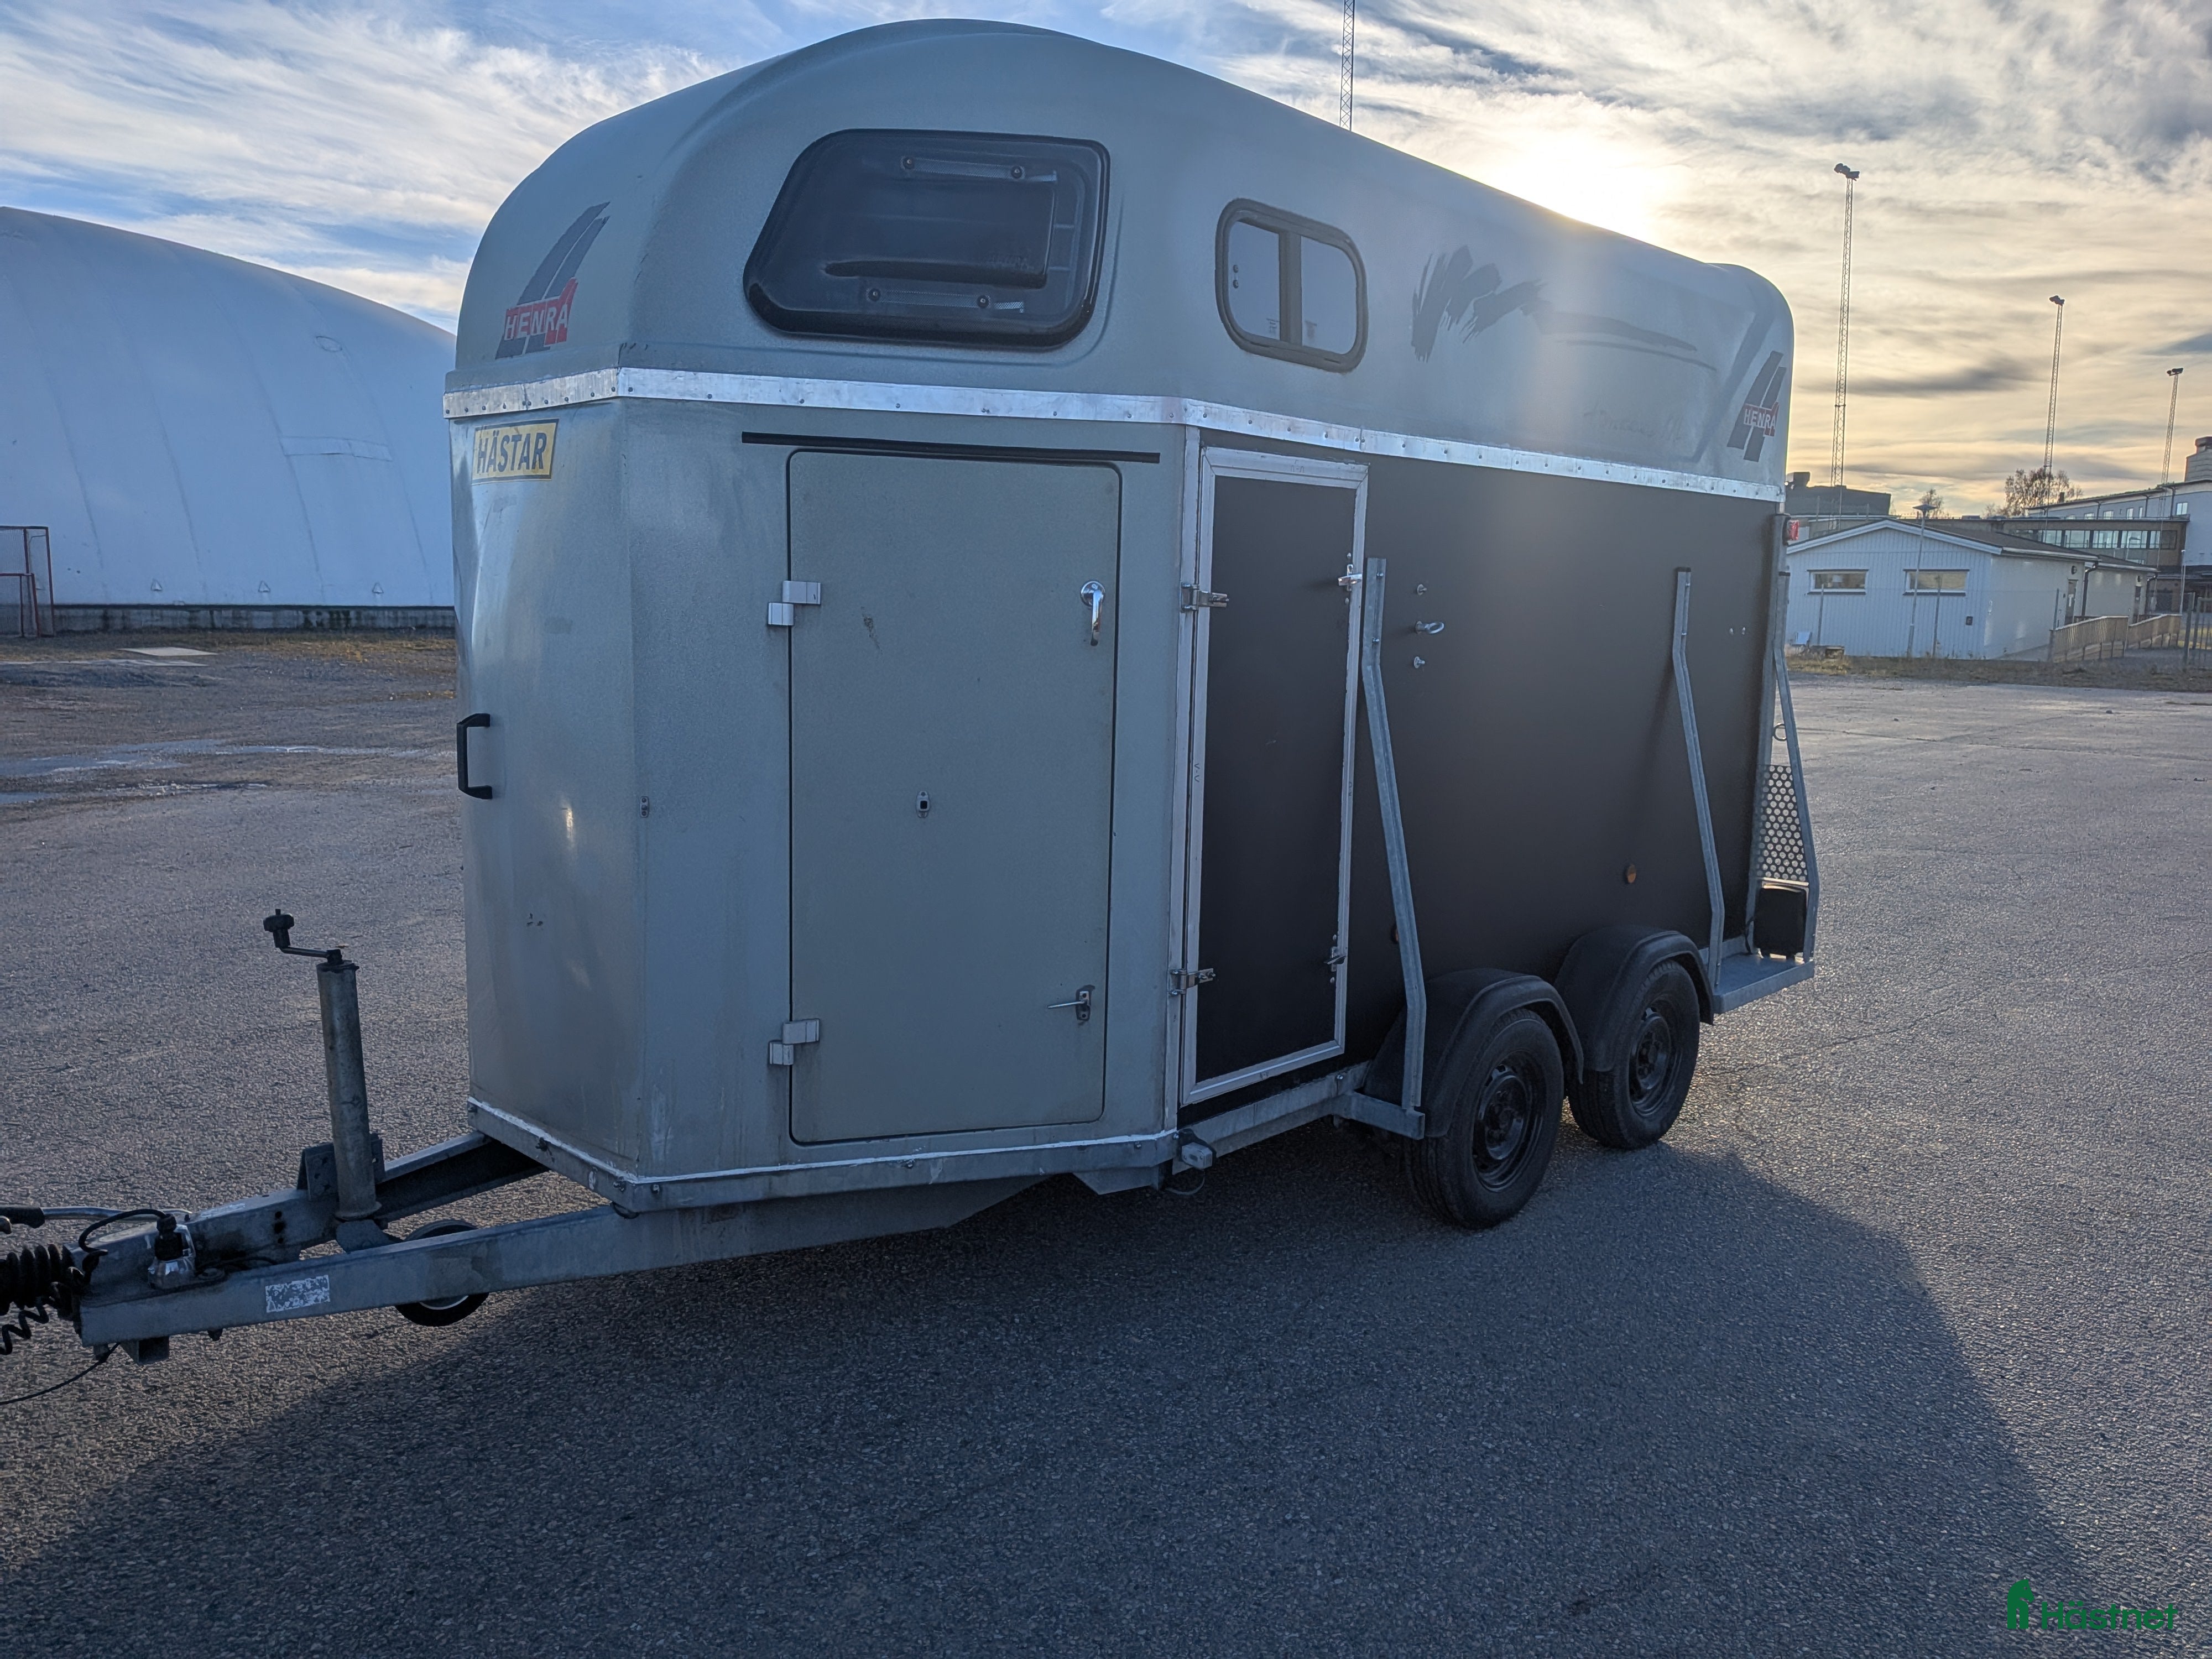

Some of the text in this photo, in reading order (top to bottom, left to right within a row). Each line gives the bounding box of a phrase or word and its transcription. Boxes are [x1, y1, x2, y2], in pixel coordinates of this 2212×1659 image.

[504, 304, 569, 341] HENRA
[1743, 408, 1776, 429] HENRA
[476, 430, 548, 475] HÄSTAR
